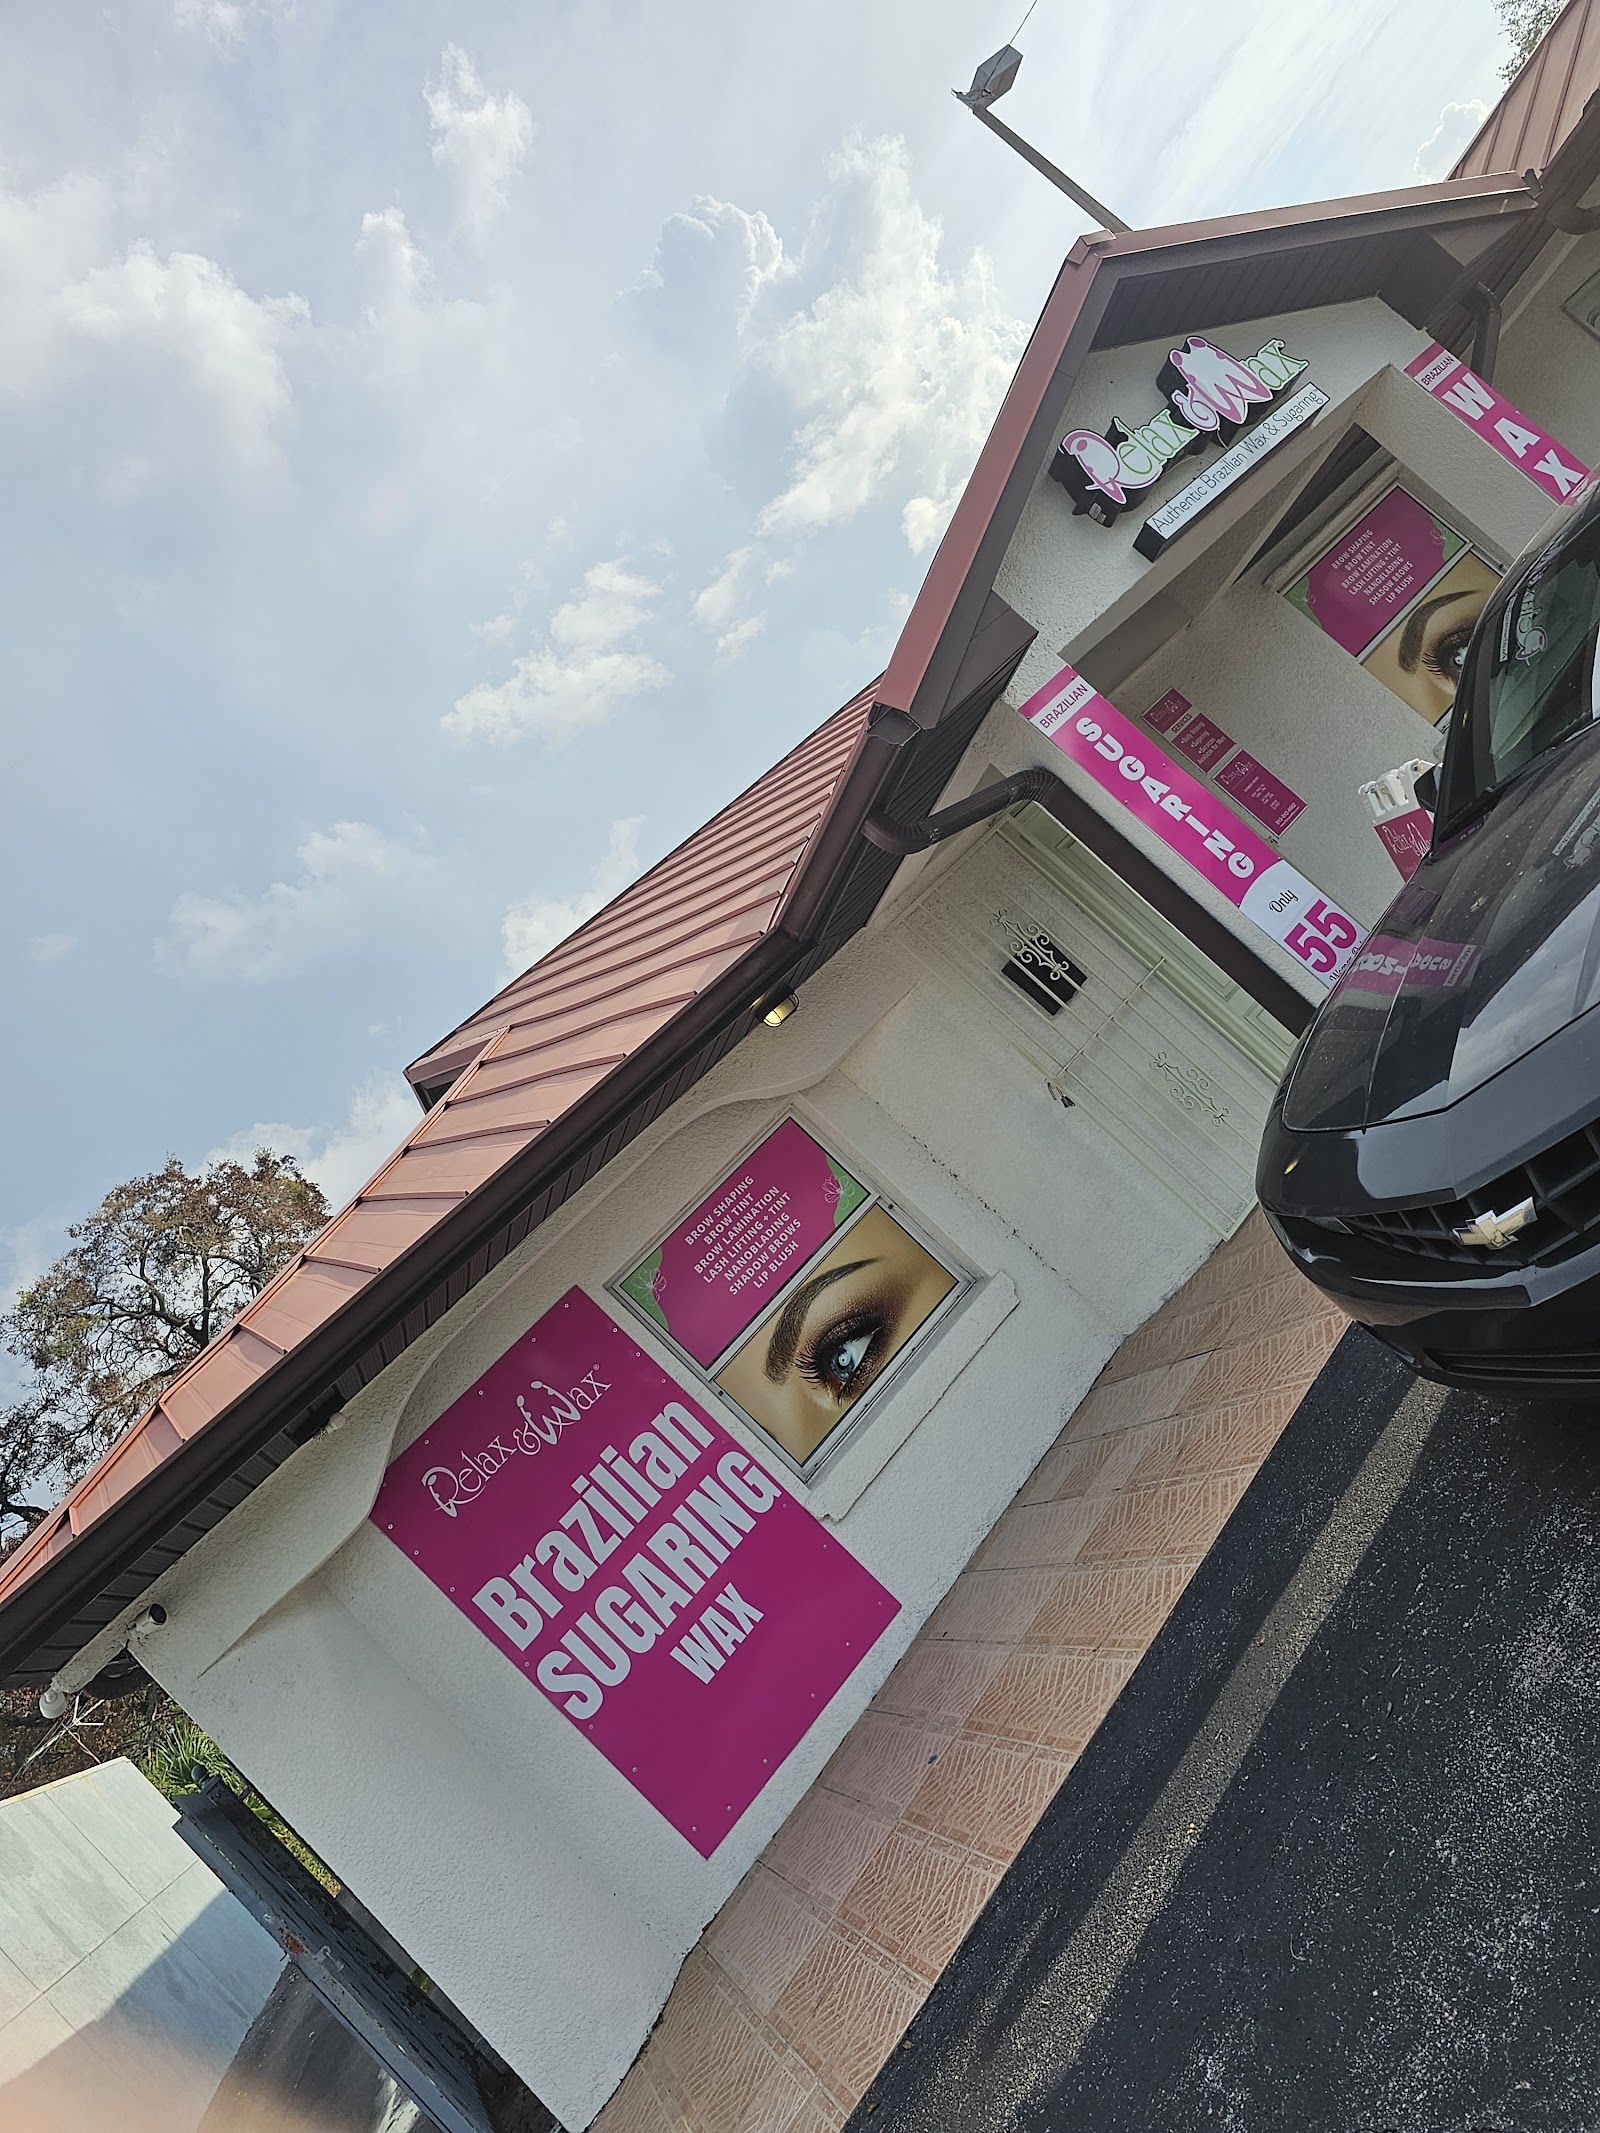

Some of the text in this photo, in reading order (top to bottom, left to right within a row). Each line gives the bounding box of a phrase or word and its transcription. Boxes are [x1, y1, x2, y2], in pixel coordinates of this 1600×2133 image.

[1421, 355, 1455, 387] BRAZILIAN
[1060, 409, 1200, 504] Relax
[1151, 391, 1324, 533] Authentic Brazilian Wax & Sugaring
[1441, 372, 1584, 497] WAX
[1331, 529, 1374, 570] BROW SHAPING
[1341, 537, 1394, 589] BROW LAMINATION
[1344, 540, 1376, 571] BROW TINT
[1348, 579, 1366, 595] LASH
[1363, 559, 1386, 582] LIFTING
[1387, 543, 1402, 558] TINT
[1363, 556, 1404, 596] NANOBLADING
[1369, 561, 1413, 606] SHADOW BROWS
[1385, 574, 1414, 603] LIP BLUSH
[1039, 684, 1089, 730] BRAZILIAN
[1170, 712, 1193, 733] SERVICES
[1075, 716, 1256, 879] SUGARING
[1269, 889, 1298, 913] Only
[1283, 899, 1357, 973] 55
[685, 1176, 754, 1245] BROW SHAPING
[694, 1186, 780, 1274] BROW LAMINATION
[703, 1256, 730, 1284] LASH
[727, 1221, 764, 1258] LIFTING
[768, 1192, 791, 1215] TINT
[704, 1193, 754, 1245] BROW TINT
[724, 1212, 790, 1281] NANOBLADING
[729, 1219, 801, 1295] SHADOW BROWS
[753, 1240, 799, 1289] LIP BLUSH
[421, 1435, 517, 1518] Relax
[471, 1401, 715, 1651] Brazilian
[537, 1450, 782, 1720] SUGARING
[669, 1581, 764, 1685] WAX
